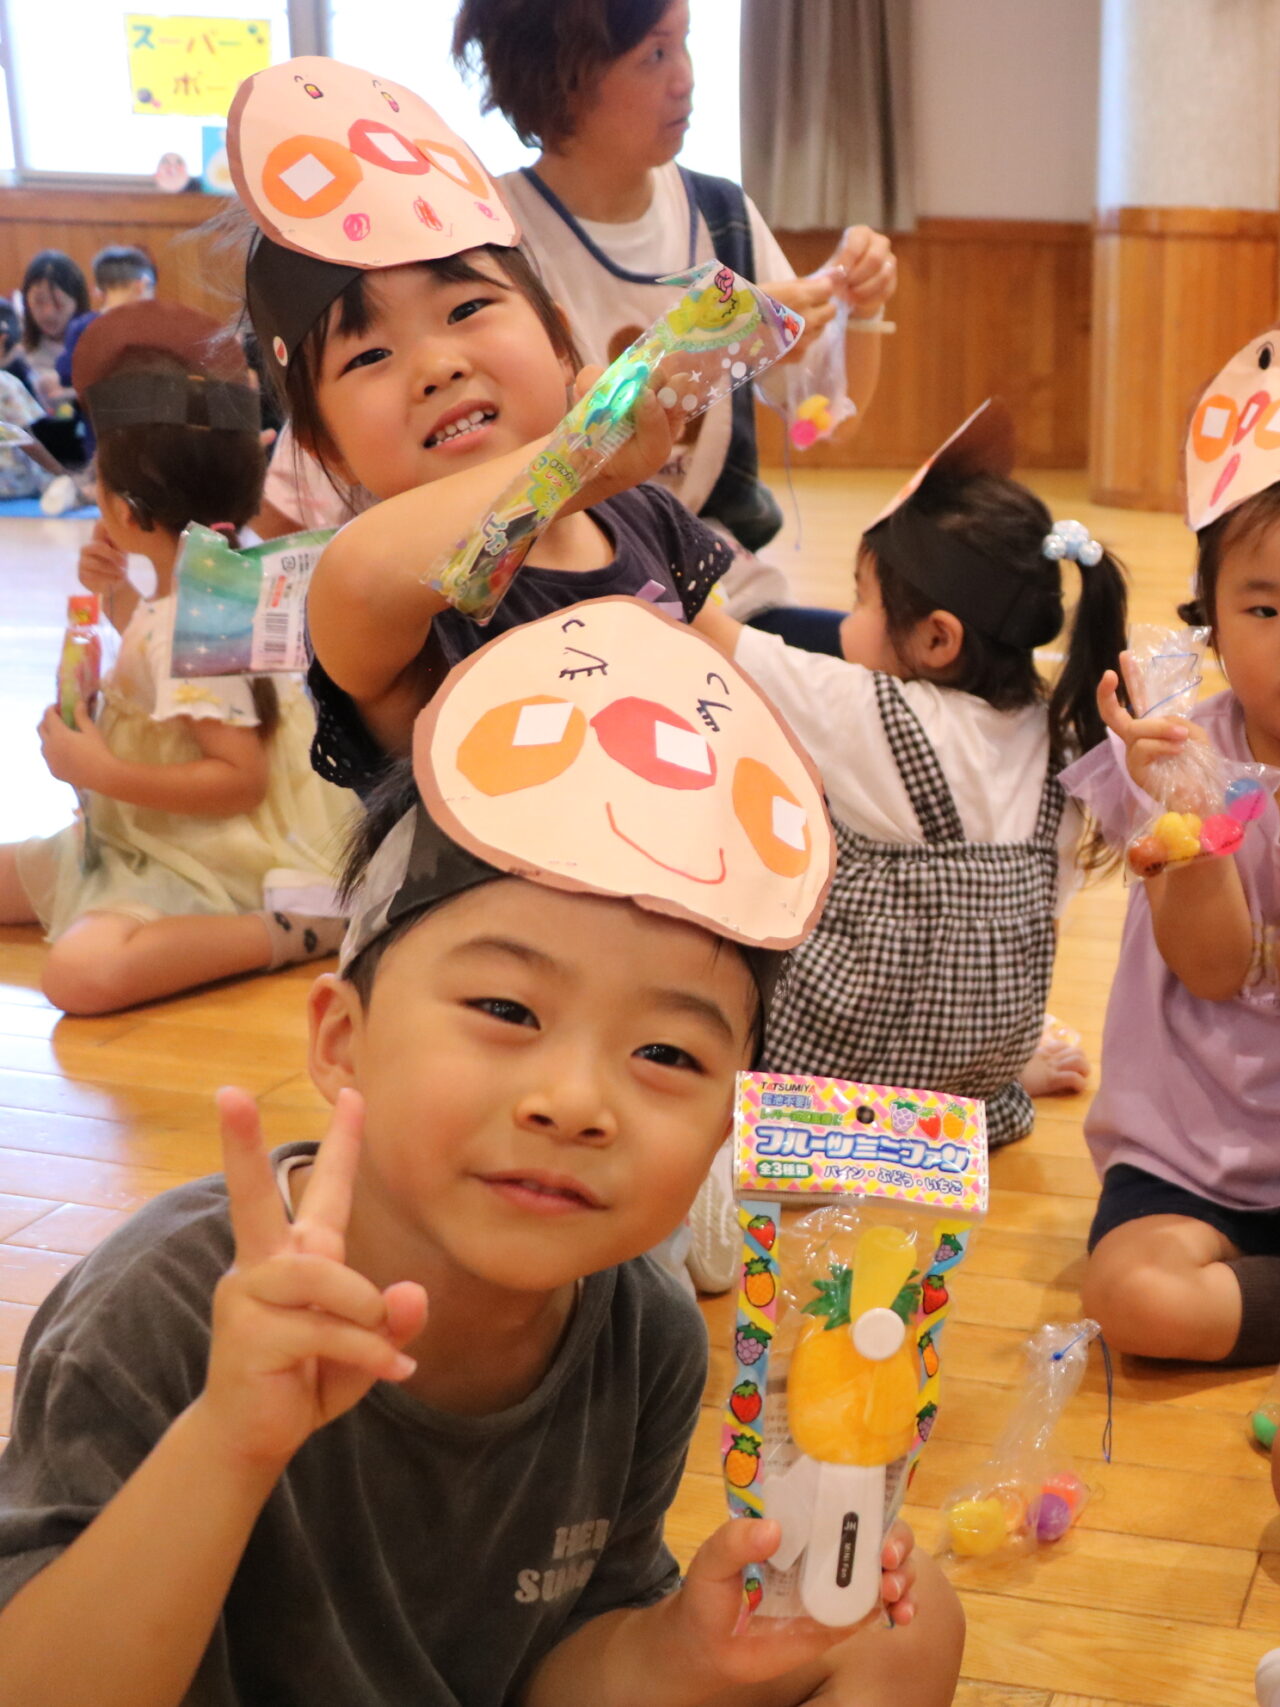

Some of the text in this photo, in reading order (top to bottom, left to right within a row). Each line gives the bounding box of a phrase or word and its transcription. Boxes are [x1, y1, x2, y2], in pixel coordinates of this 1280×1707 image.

[762, 1081, 816, 1094] TATSUMIYA
[755, 1126, 970, 1173] フルーツミニファン
